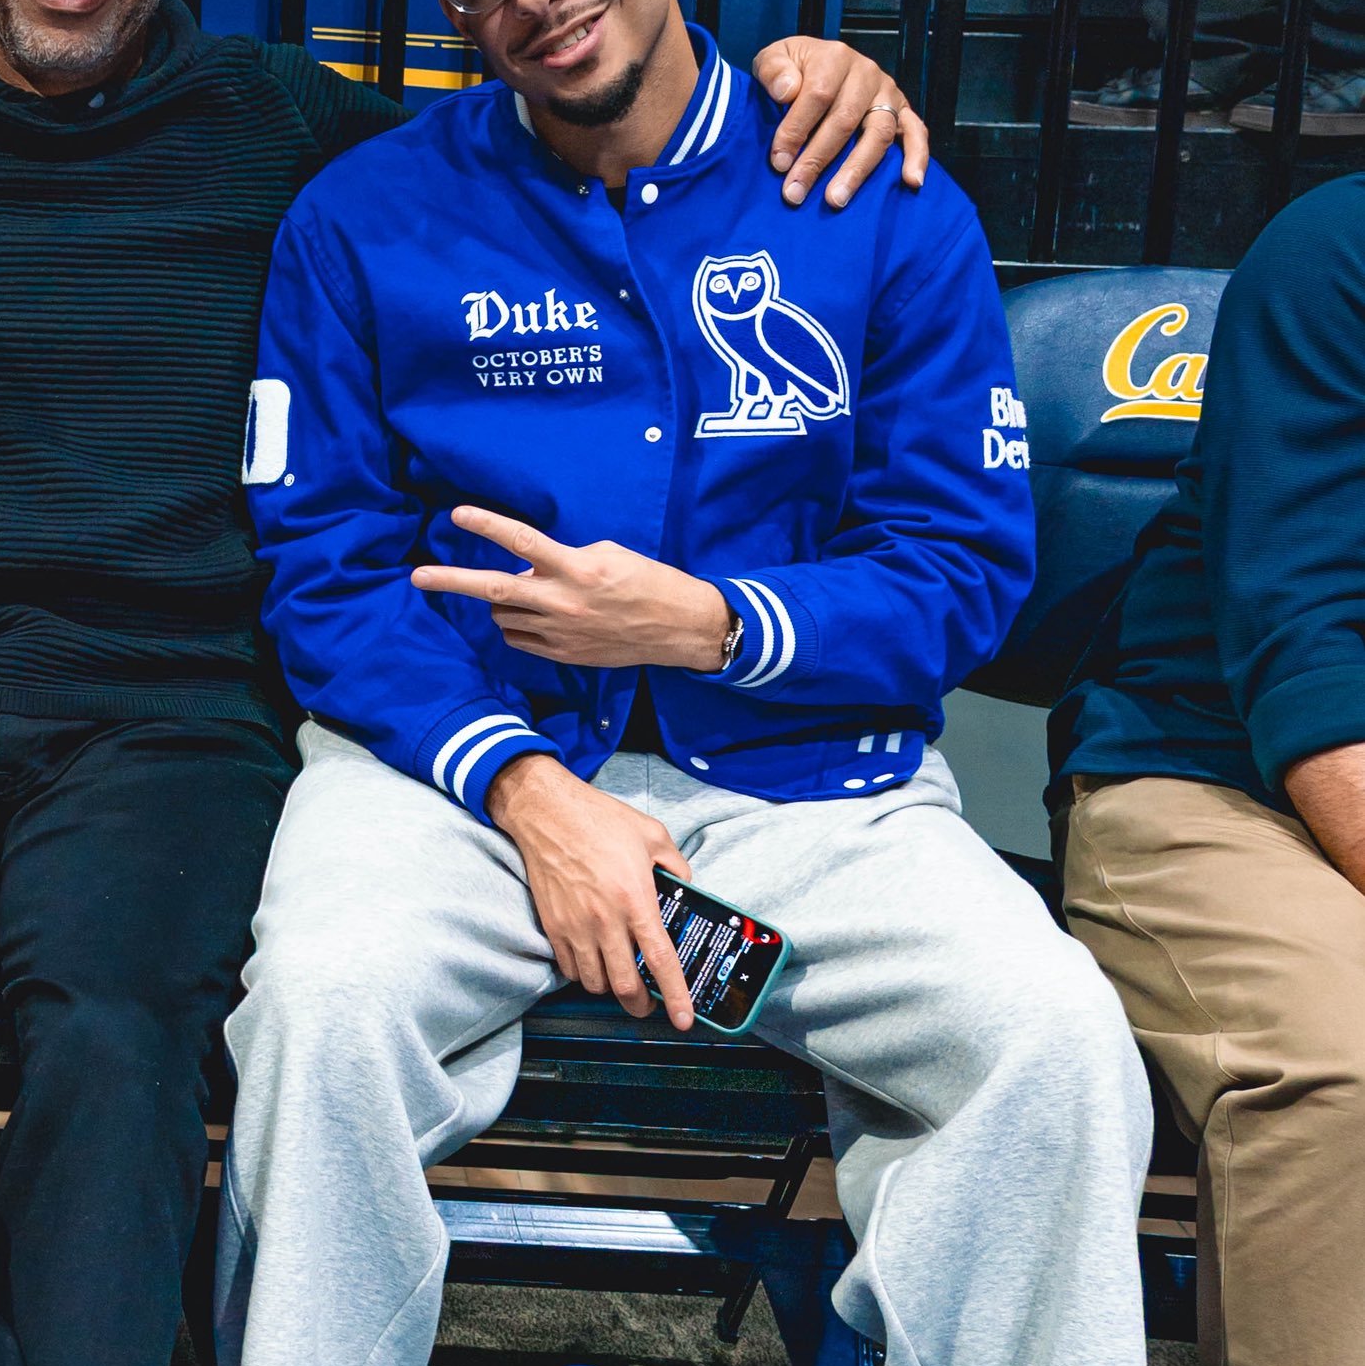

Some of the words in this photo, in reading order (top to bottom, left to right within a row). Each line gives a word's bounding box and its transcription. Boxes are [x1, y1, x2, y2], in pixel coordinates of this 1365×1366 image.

[460, 288, 599, 341] Duke
[472, 345, 603, 369] OCTOBER'S
[476, 371, 537, 387] VERY
[546, 366, 603, 385] OWN
